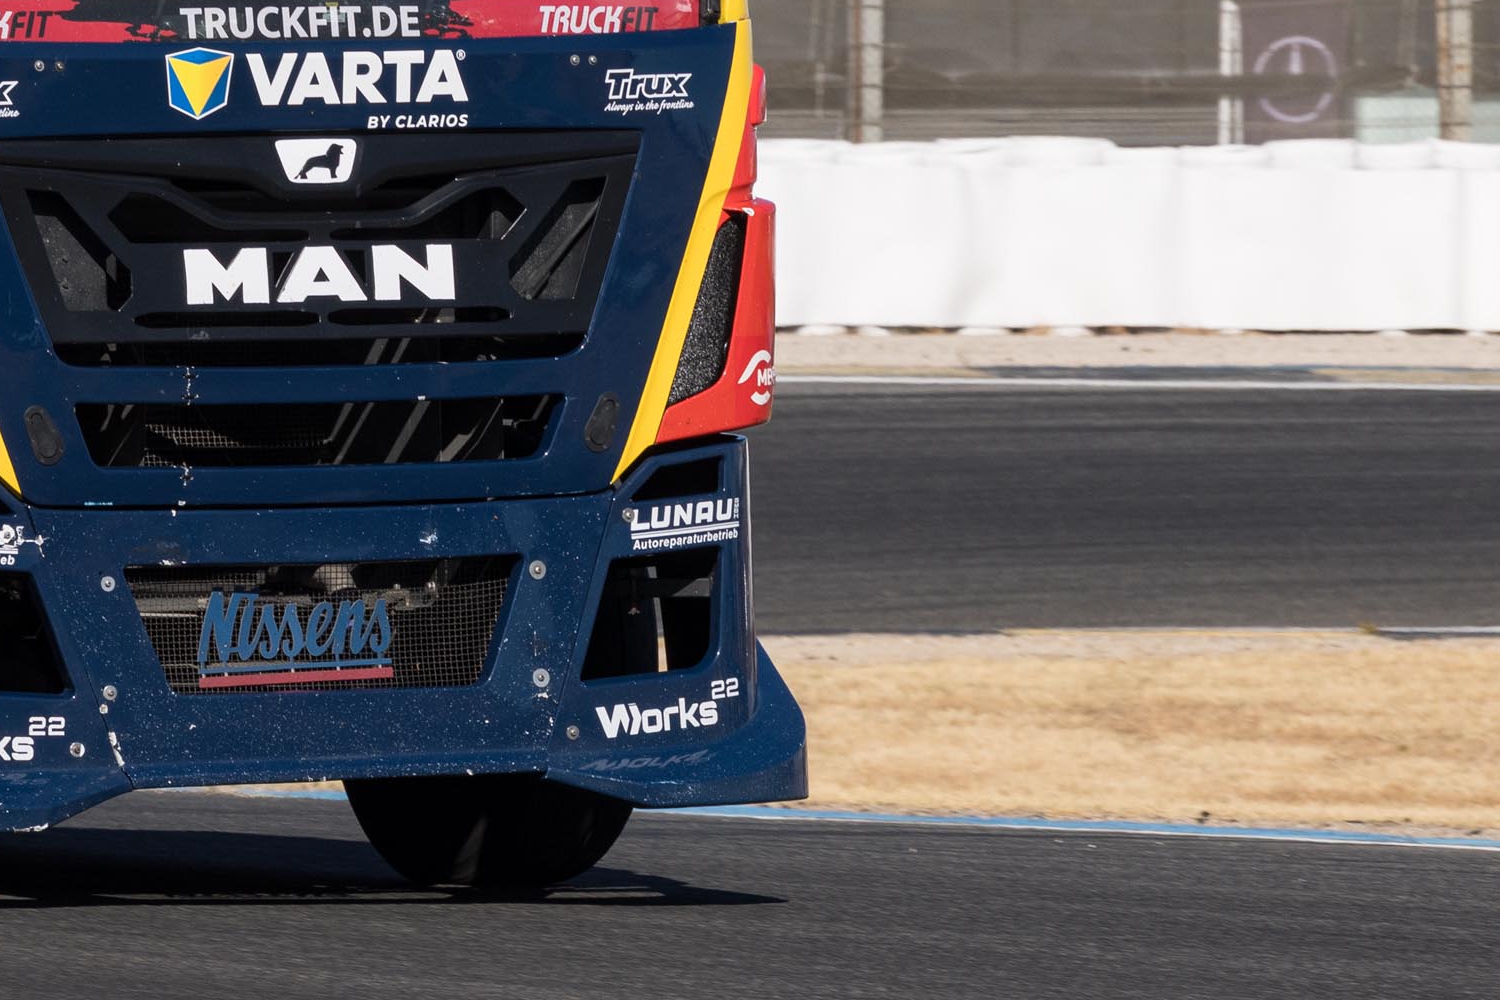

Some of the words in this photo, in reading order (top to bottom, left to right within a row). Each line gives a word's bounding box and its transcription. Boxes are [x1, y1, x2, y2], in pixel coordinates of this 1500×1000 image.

[180, 4, 421, 39] TRUCKFIT.DE
[540, 5, 659, 34] TRUCKFIT
[245, 49, 469, 106] VARTA
[604, 68, 692, 99] Trux
[367, 115, 390, 129] BY
[395, 114, 469, 128] CLARIOS
[604, 101, 634, 116] Always
[634, 101, 645, 111] in
[645, 99, 659, 111] the
[656, 99, 695, 115] frontline
[183, 244, 456, 305] MAN
[630, 498, 733, 531] LUNAU
[633, 528, 739, 550] Autoreparaturbetrieb
[197, 591, 393, 662] Nissens
[596, 698, 718, 739] Works
[710, 677, 740, 700] 22
[28, 716, 65, 736] 22
